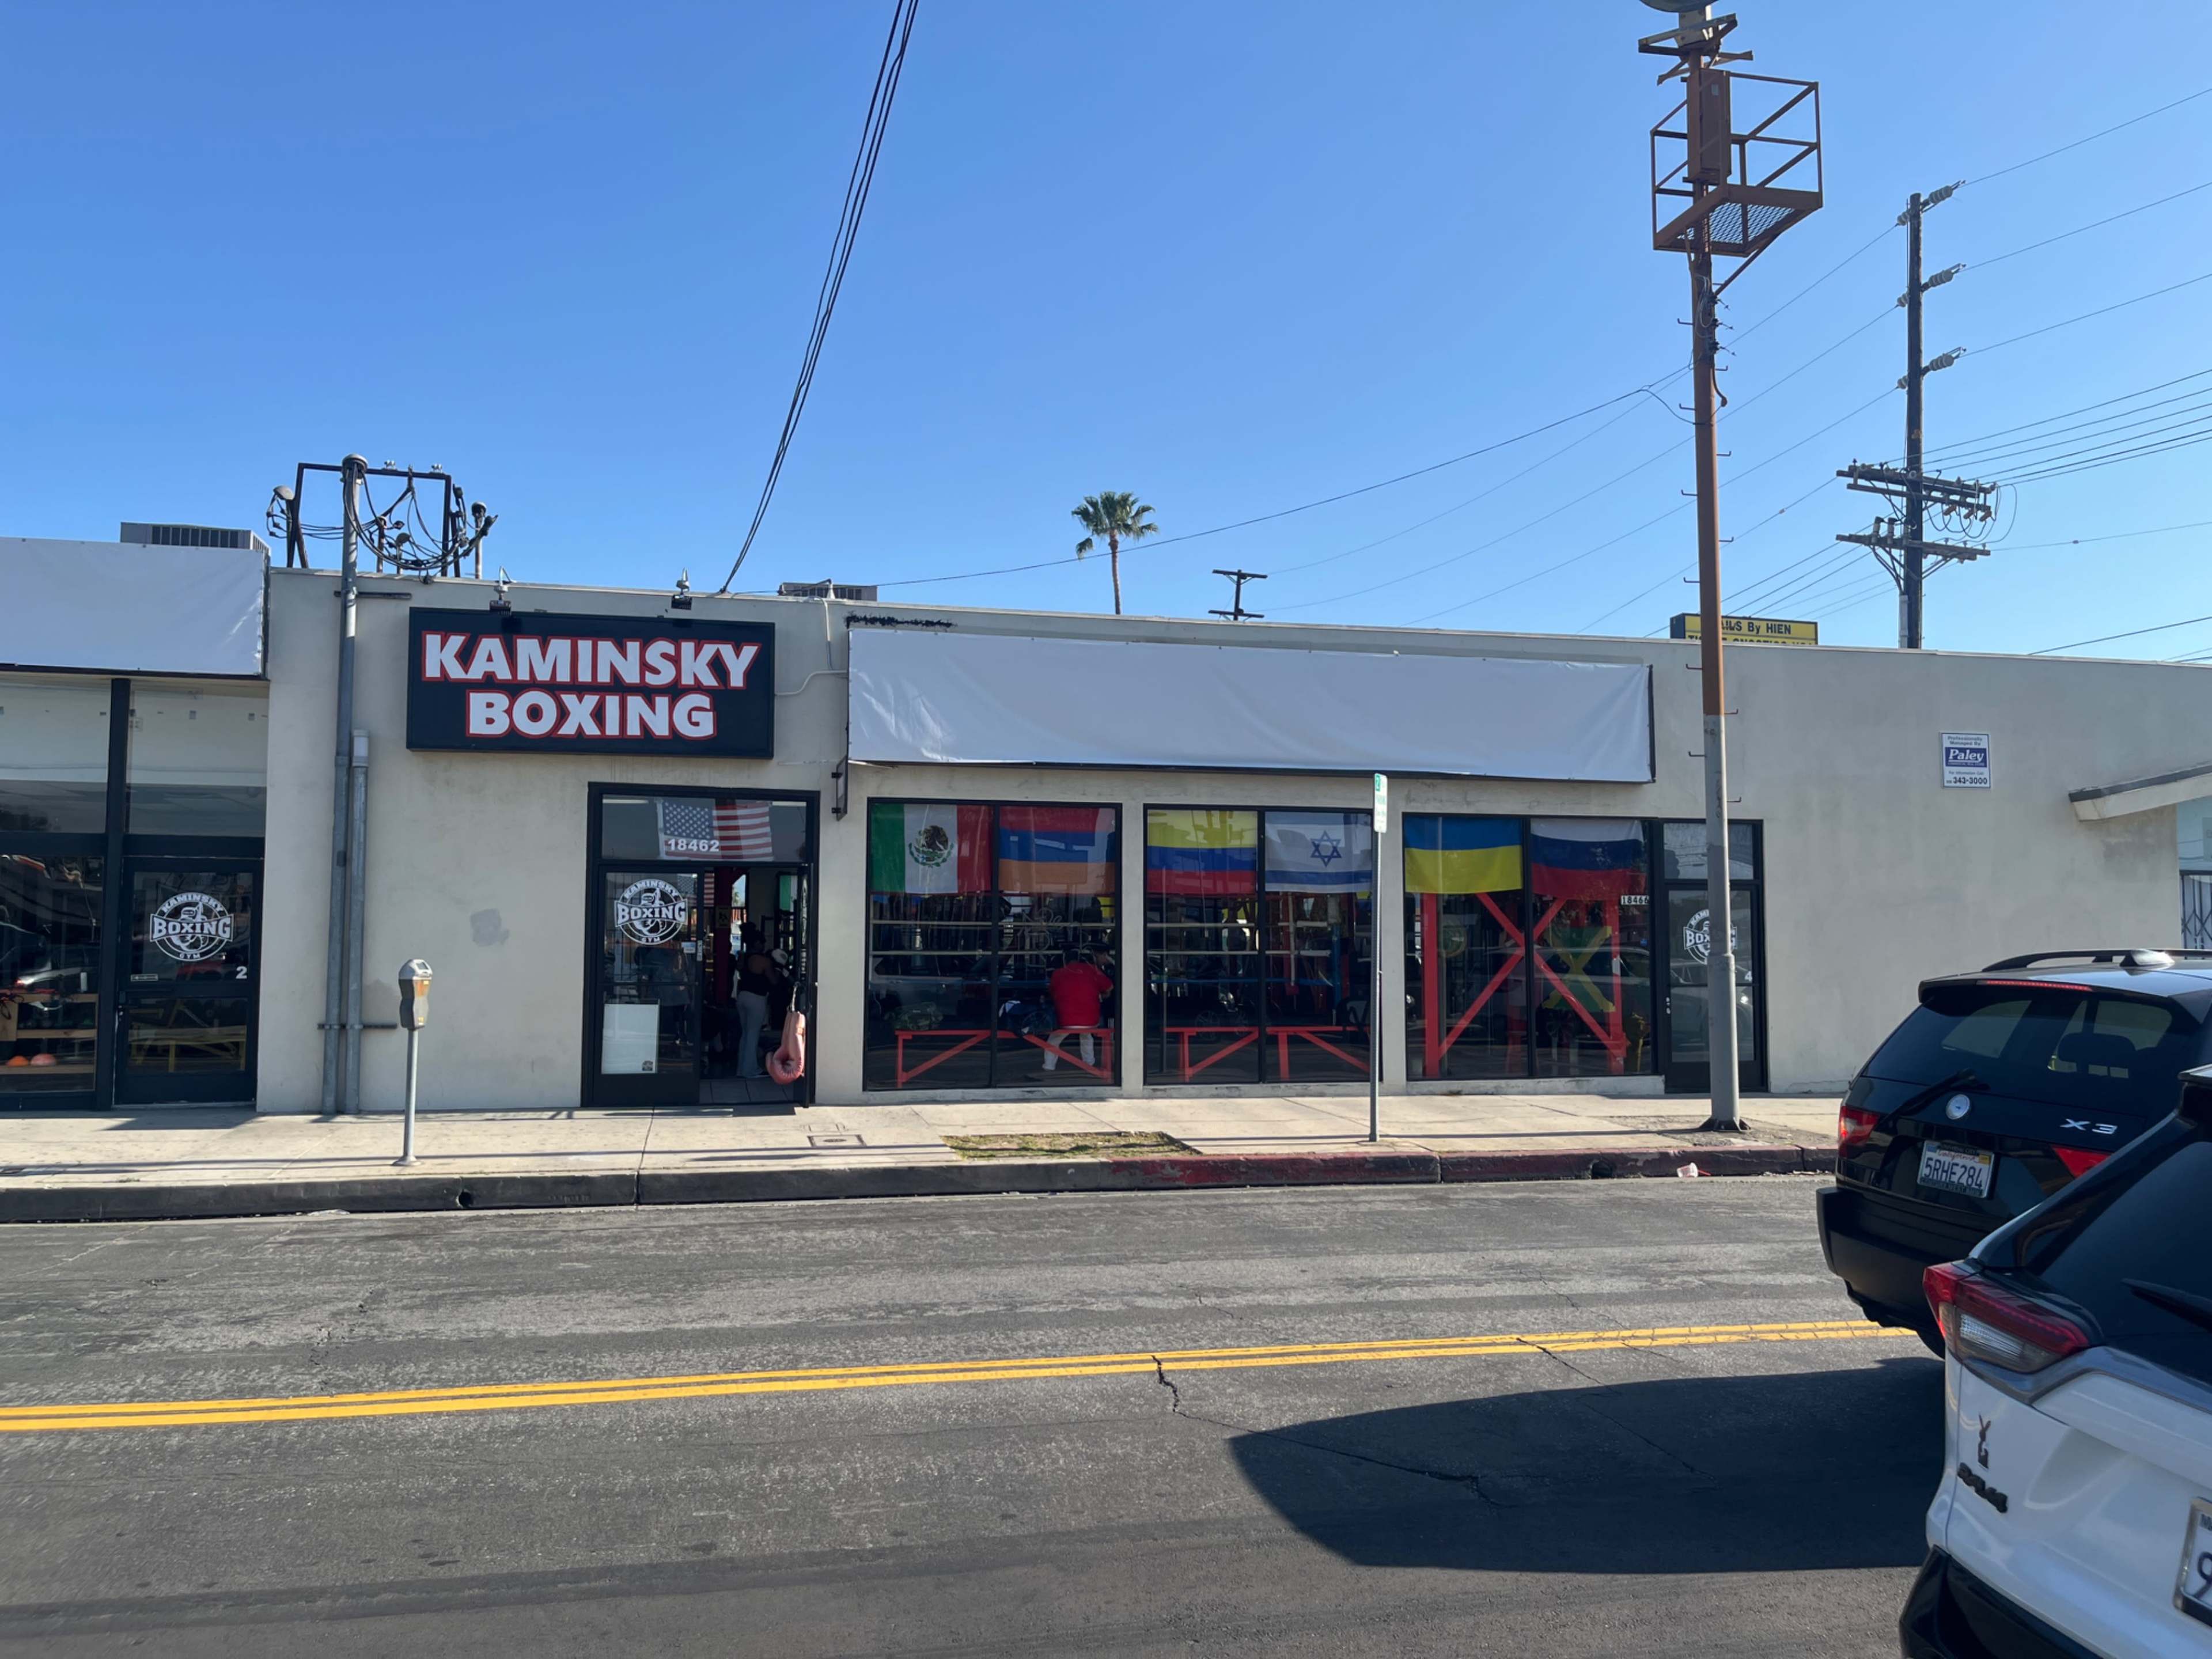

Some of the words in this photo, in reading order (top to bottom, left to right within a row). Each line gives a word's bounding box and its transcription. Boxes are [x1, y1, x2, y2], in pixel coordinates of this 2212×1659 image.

[1748, 623, 1761, 634] By
[1766, 623, 1791, 635] HIEN
[422, 631, 762, 688] KAMINSKY
[465, 688, 717, 740] BOXING
[1948, 748, 1984, 762] Paley
[1953, 777, 1988, 785] 343-3000
[668, 838, 719, 852] 18462
[624, 880, 680, 899] KAMINSKY
[161, 893, 224, 913] KAMINSKY
[1622, 896, 1649, 904] 18466
[617, 902, 686, 925] BOXING
[153, 917, 231, 939] BOXING
[236, 966, 247, 979] 2
[1744, 971, 1752, 982] 4
[2059, 1118, 2118, 1134] X3
[1924, 1157, 1983, 1188] 5RHE284
